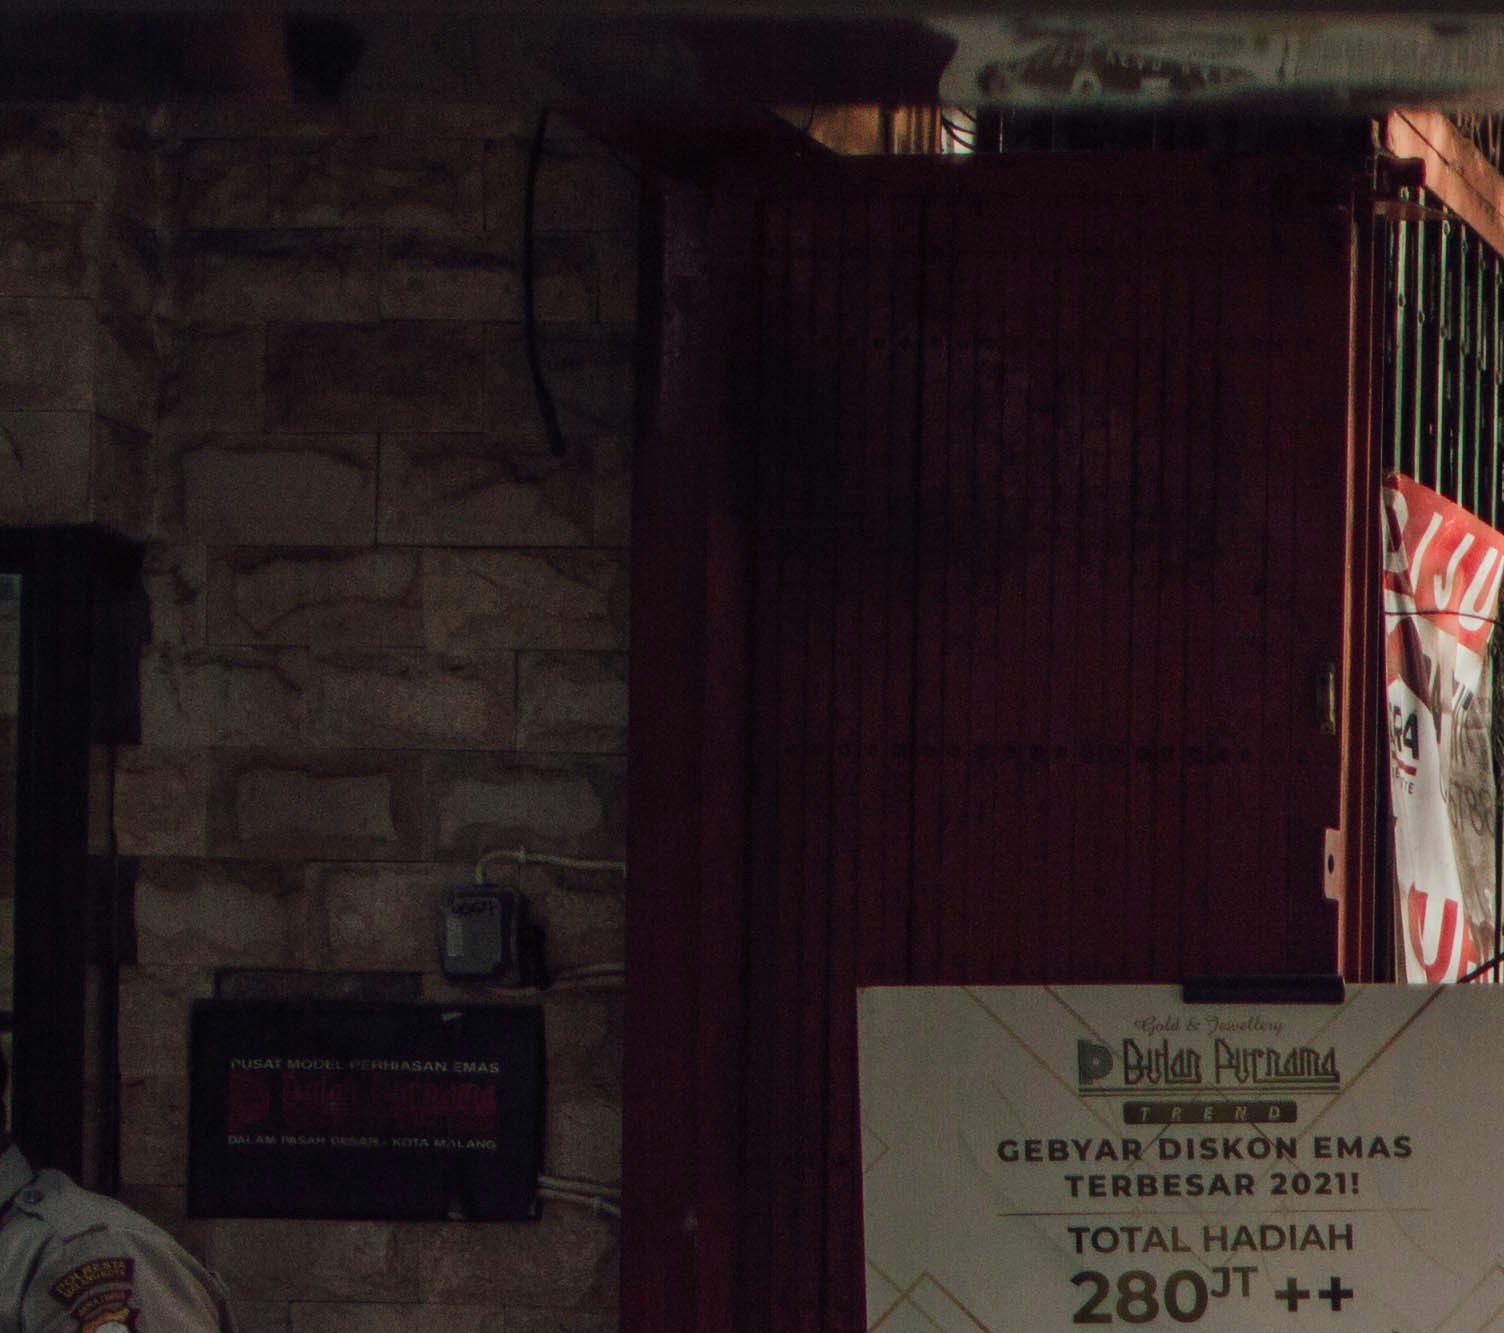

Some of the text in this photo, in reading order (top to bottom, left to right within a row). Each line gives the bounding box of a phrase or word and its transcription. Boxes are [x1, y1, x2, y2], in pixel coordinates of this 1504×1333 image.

[997, 1135, 1413, 1163] GEBYAR DISKON EMAS
[1064, 1171, 1361, 1198] TERBESAR 2021!
[1068, 1223, 1354, 1254] TOTAL HADIAH
